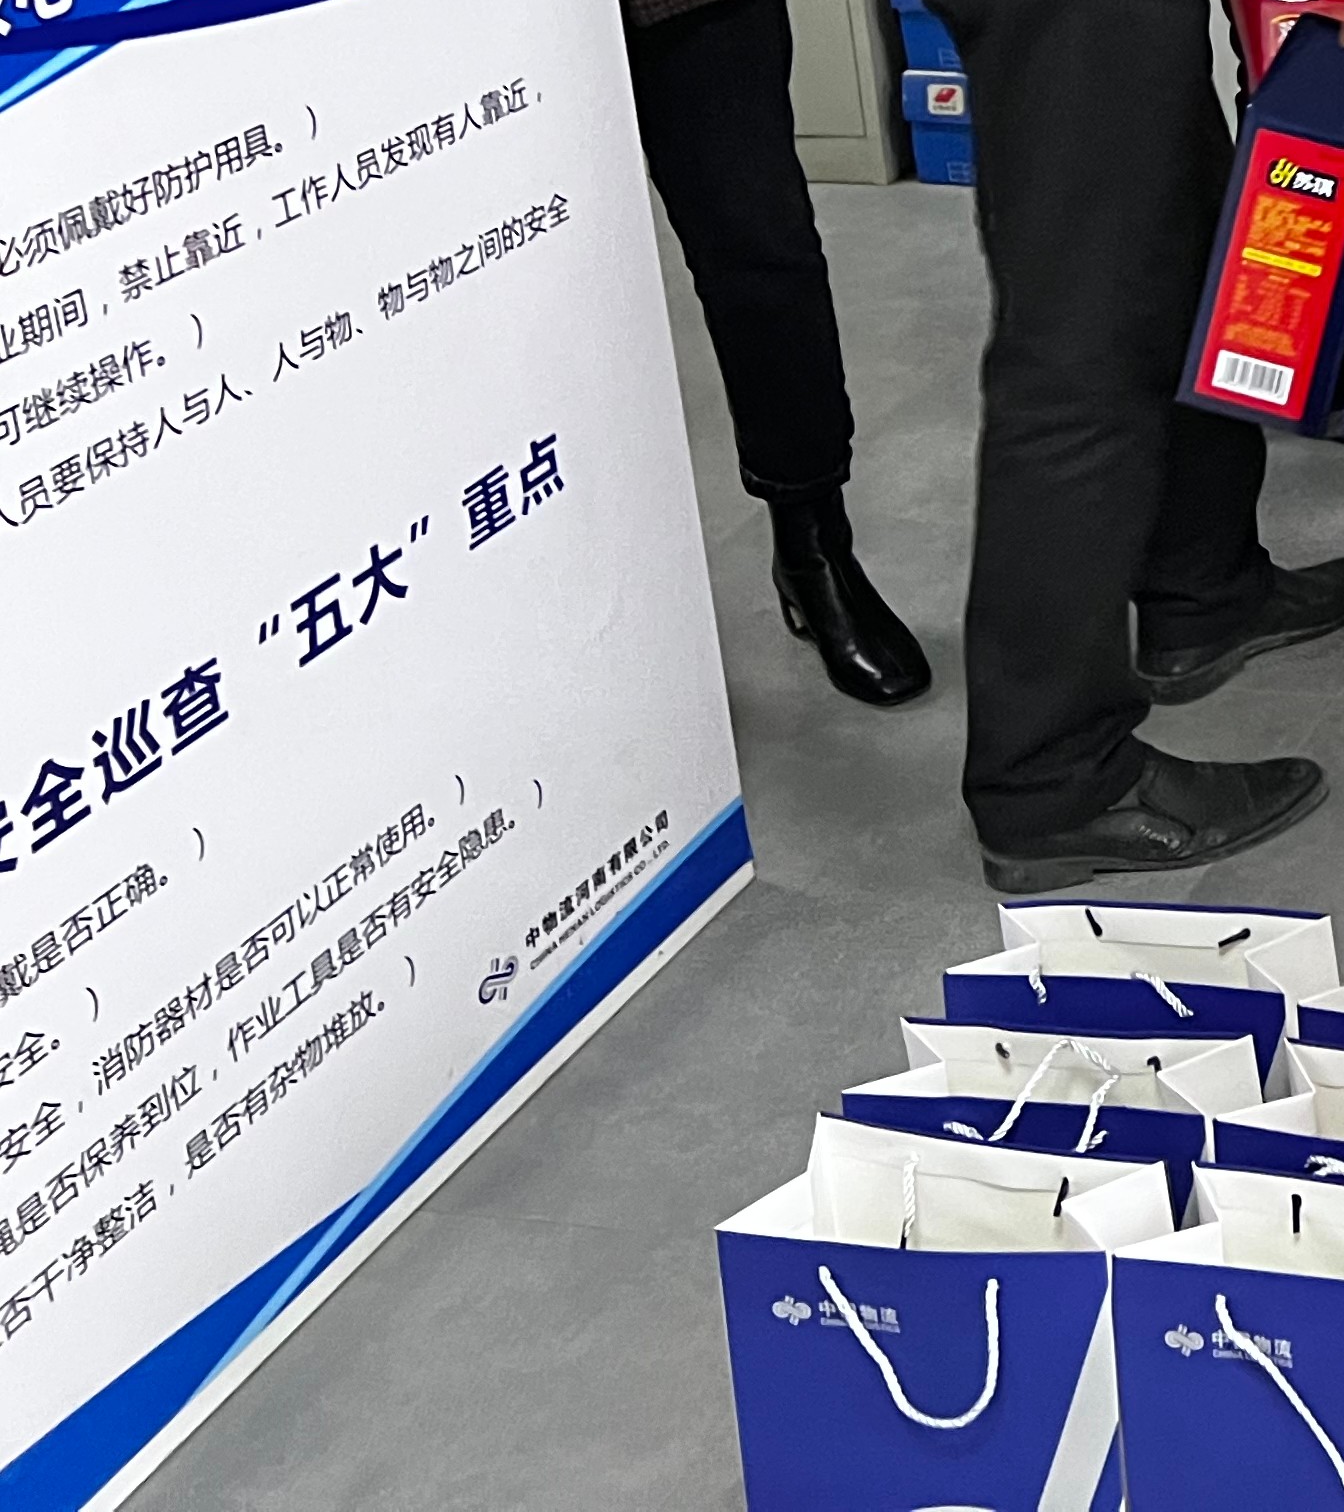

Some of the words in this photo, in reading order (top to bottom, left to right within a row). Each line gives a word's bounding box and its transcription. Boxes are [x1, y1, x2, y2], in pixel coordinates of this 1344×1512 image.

[526, 809, 670, 949] 中物流河南有限公司
